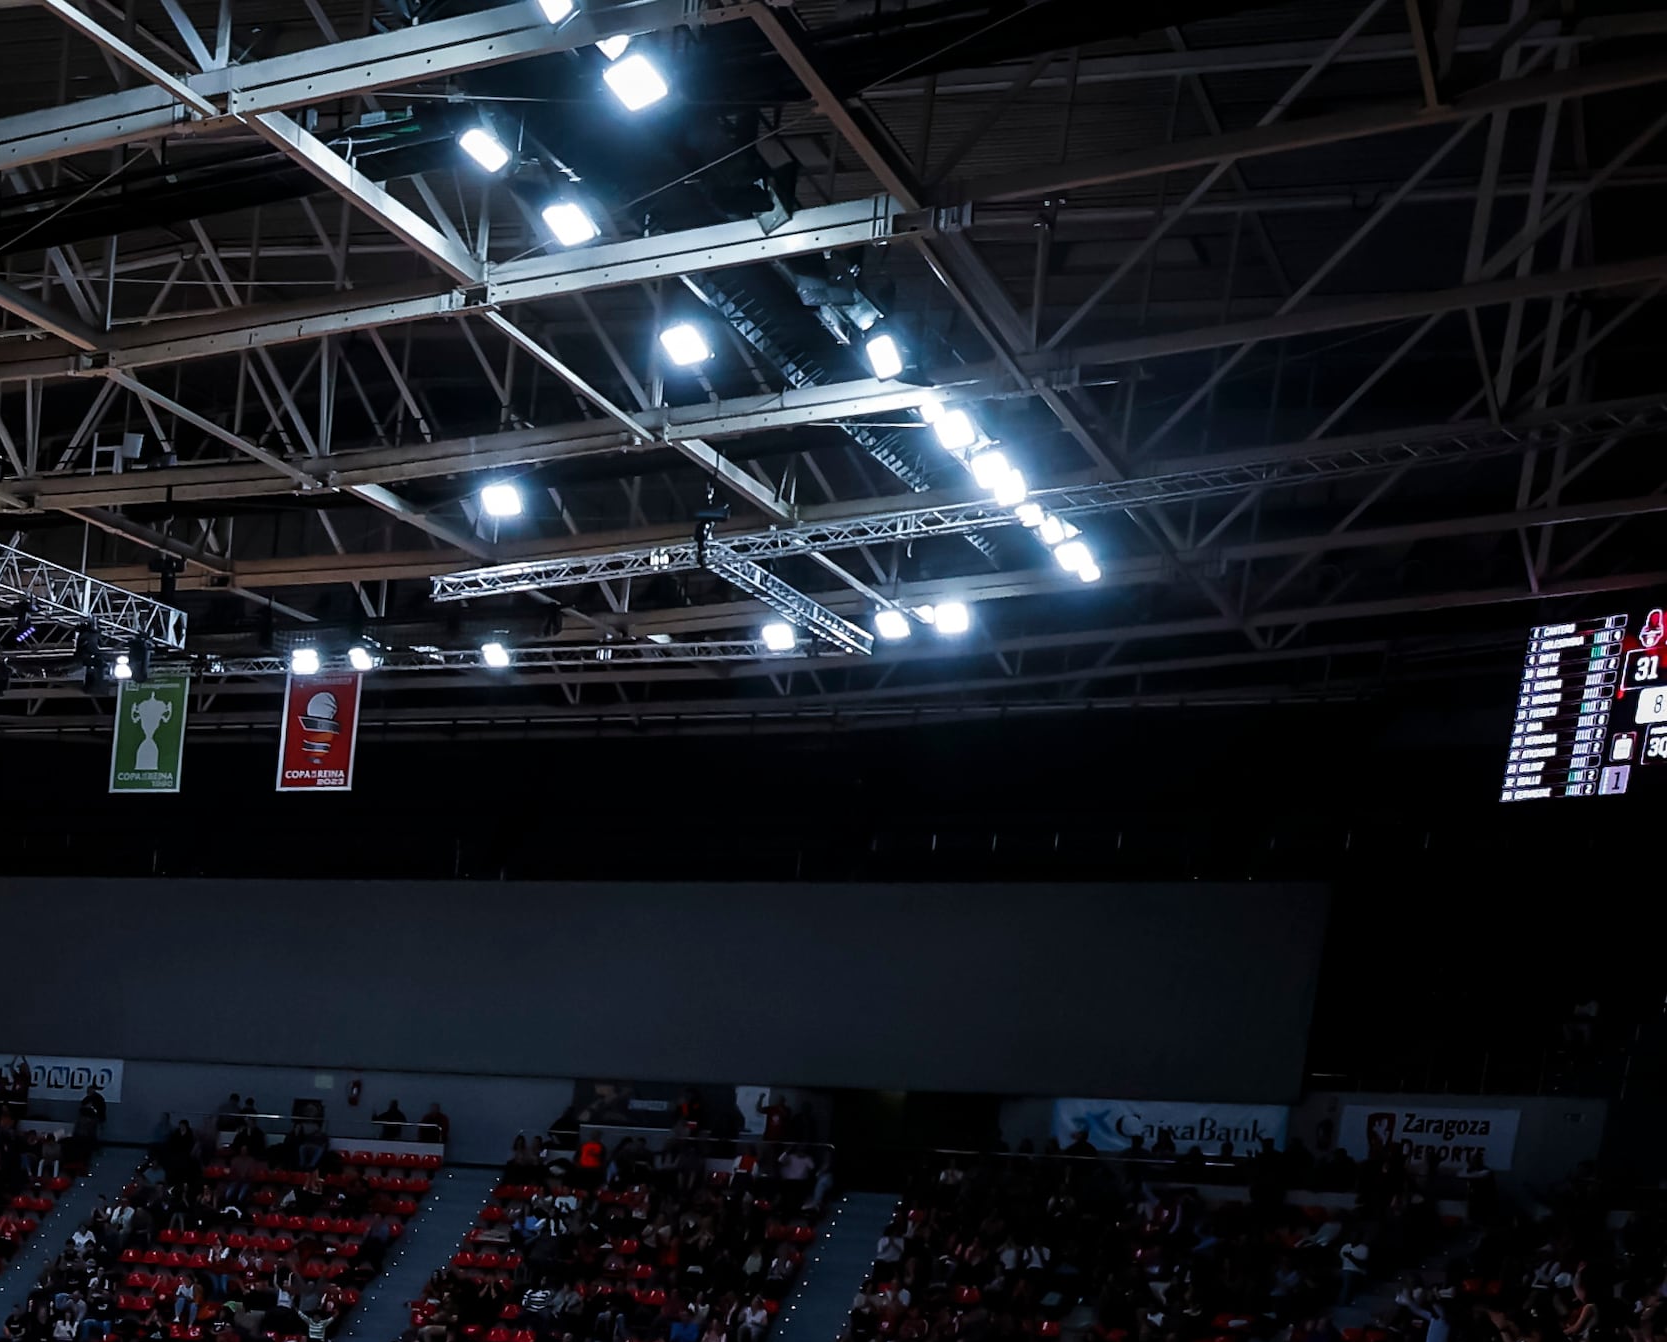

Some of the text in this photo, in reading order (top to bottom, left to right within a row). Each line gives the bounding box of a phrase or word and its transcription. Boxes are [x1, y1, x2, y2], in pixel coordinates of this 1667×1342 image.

[1634, 655, 1659, 682] 31
[117, 772, 142, 782] COPA
[285, 770, 345, 779] COPA REINA
[317, 778, 345, 786] 2023
[1612, 771, 1620, 790] 1
[1115, 1114, 1266, 1141] CaixaBank
[1402, 1112, 1491, 1140] Zaragoza
